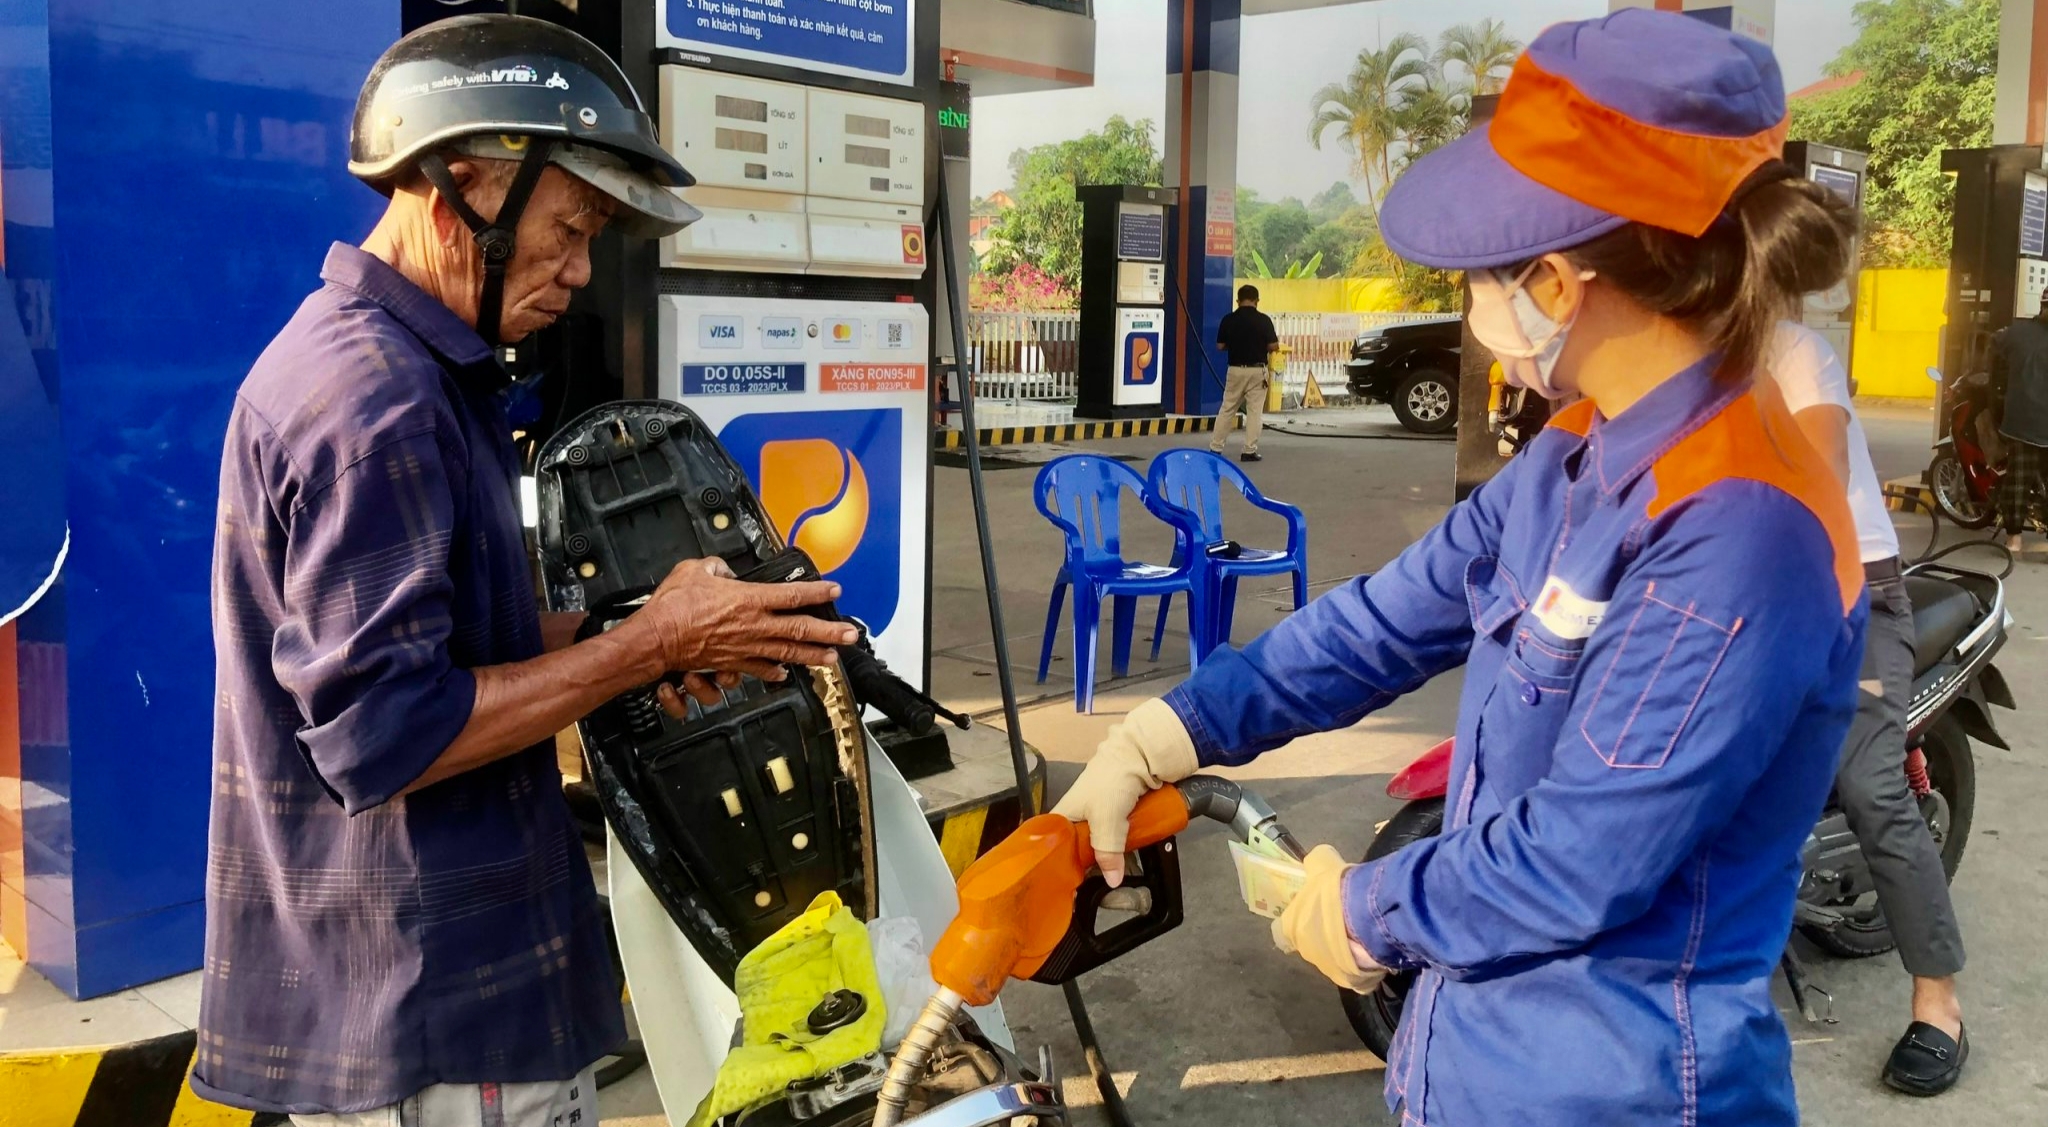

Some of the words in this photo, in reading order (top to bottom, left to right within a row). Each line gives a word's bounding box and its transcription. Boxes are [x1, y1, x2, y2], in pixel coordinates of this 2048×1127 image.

[874, 1, 893, 15] bơm
[687, 0, 695, 9] 5.
[697, 0, 720, 16] Thực
[722, 2, 741, 18] hiện
[742, 6, 766, 21] thanh
[768, 12, 786, 25] toán
[788, 15, 798, 27] và
[800, 18, 814, 31] xác
[816, 21, 835, 37] nhận
[837, 22, 848, 38] kết
[850, 28, 866, 42] quả,
[868, 32, 884, 44] cảm
[697, 17, 709, 28] ơn
[711, 17, 737, 33] khách
[739, 24, 763, 40] hàng.
[679, 52, 711, 63] TATSUNO
[431, 75, 463, 88] safely
[466, 71, 491, 84] with
[778, 141, 788, 150] LÍT
[709, 326, 735, 338] VISA
[767, 329, 789, 339] napas
[704, 366, 728, 381] DO
[732, 366, 785, 382] 0,05S-II
[832, 365, 864, 380] XĂNG
[867, 367, 916, 380] RON95-III
[701, 383, 727, 393] TCCS
[729, 383, 740, 393] 03
[748, 382, 788, 392] 2023/PLX
[836, 382, 858, 391] TCCS
[860, 382, 869, 391] 01
[876, 381, 910, 391] 2023/PLX
[1191, 780, 1233, 793] Galaxy
